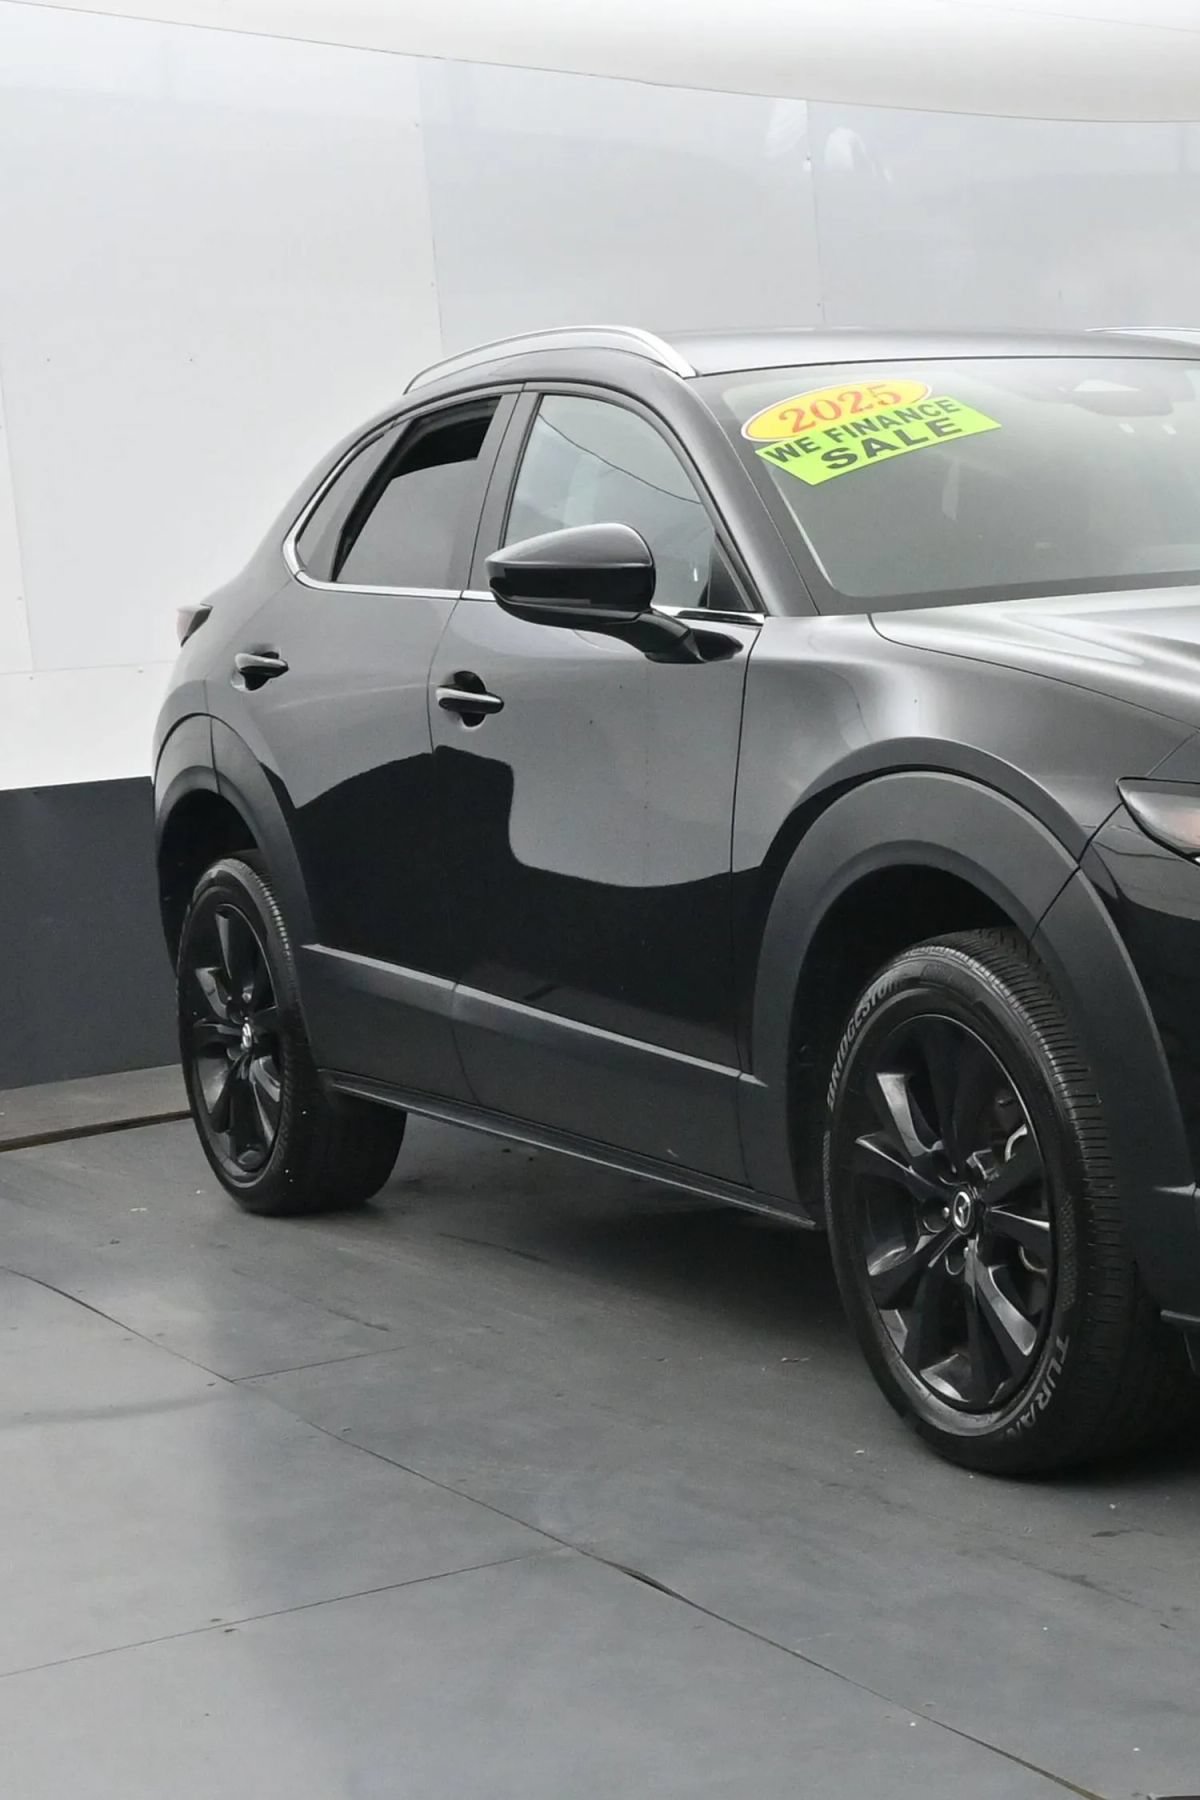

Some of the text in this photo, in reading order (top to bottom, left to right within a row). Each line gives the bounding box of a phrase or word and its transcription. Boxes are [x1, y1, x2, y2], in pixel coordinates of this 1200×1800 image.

[764, 399, 962, 463] WE FINANCE
[778, 384, 902, 433] 2025
[820, 417, 962, 470] SALE
[826, 977, 902, 1112] BRIDGESTON
